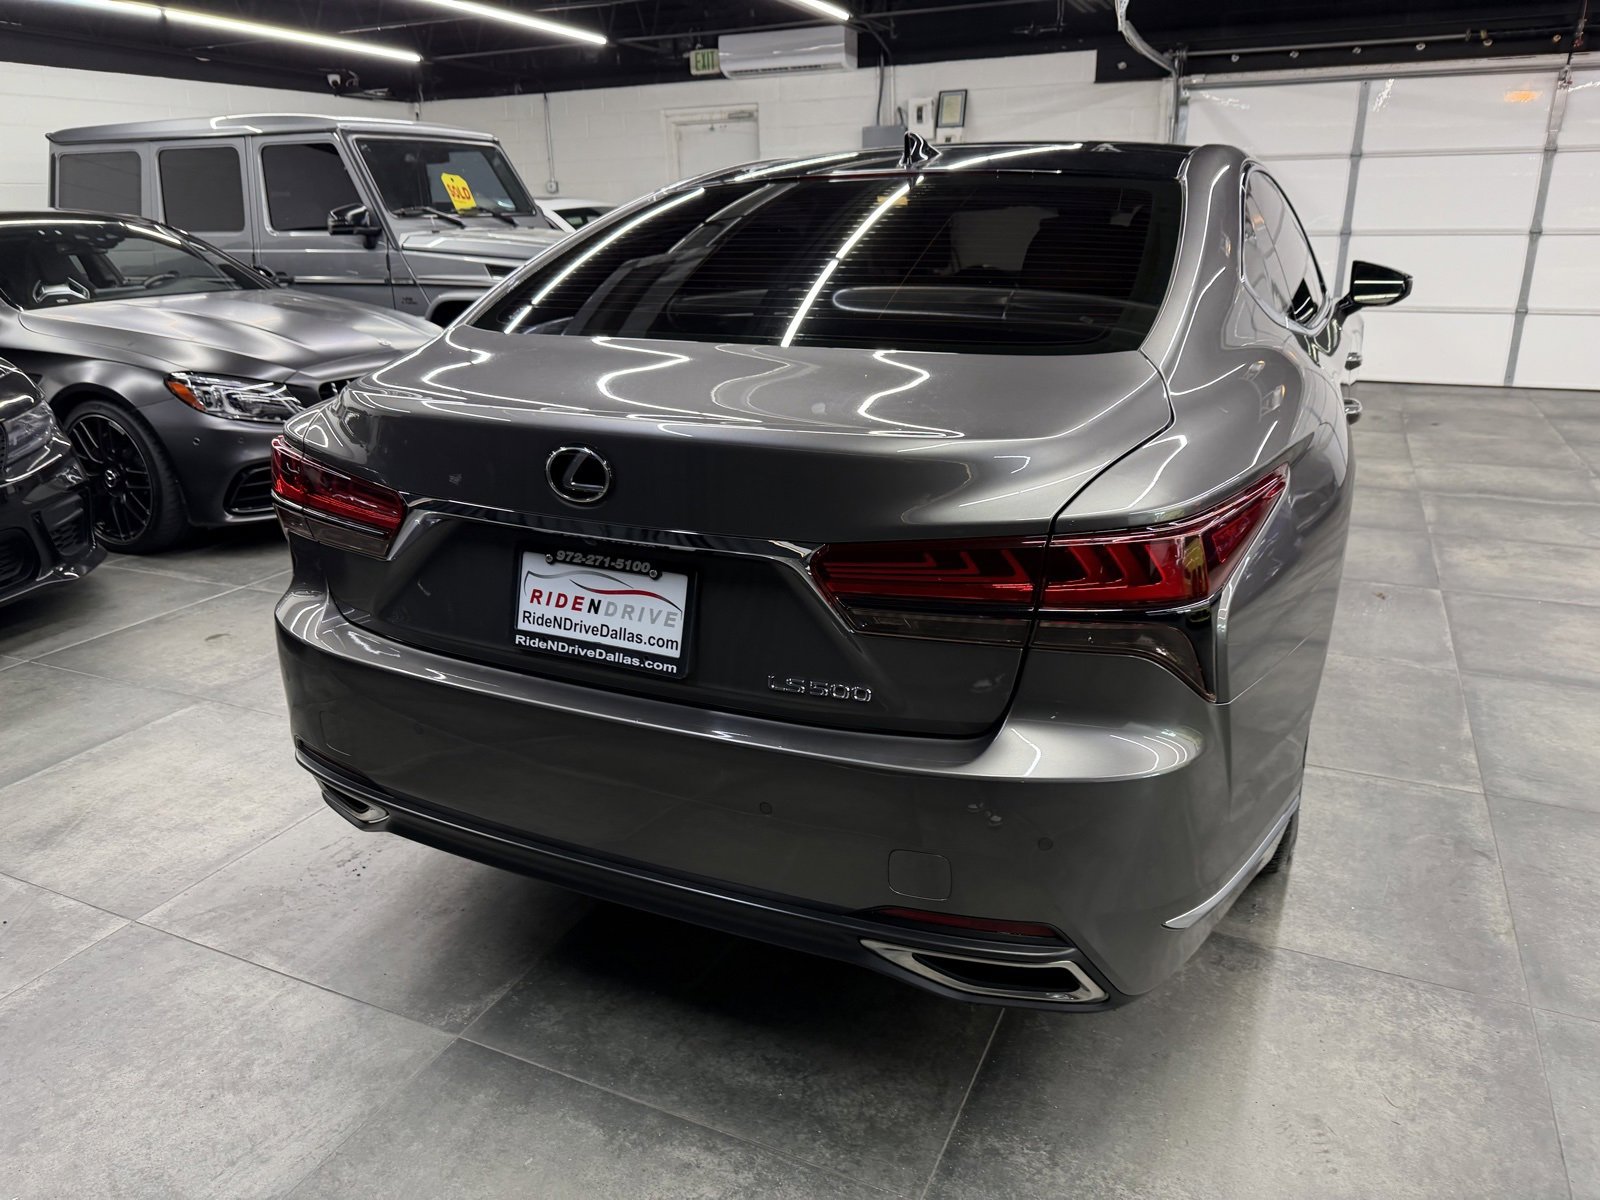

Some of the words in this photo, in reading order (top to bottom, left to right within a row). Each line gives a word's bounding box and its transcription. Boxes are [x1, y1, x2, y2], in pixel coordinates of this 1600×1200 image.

[695, 51, 715, 71] EXIT
[556, 550, 651, 573] 972-271-5100
[530, 588, 679, 628] RIDENDRIVE
[522, 610, 679, 651] RideNDriveDallas.com
[515, 634, 677, 674] RideNDriveDallas.com
